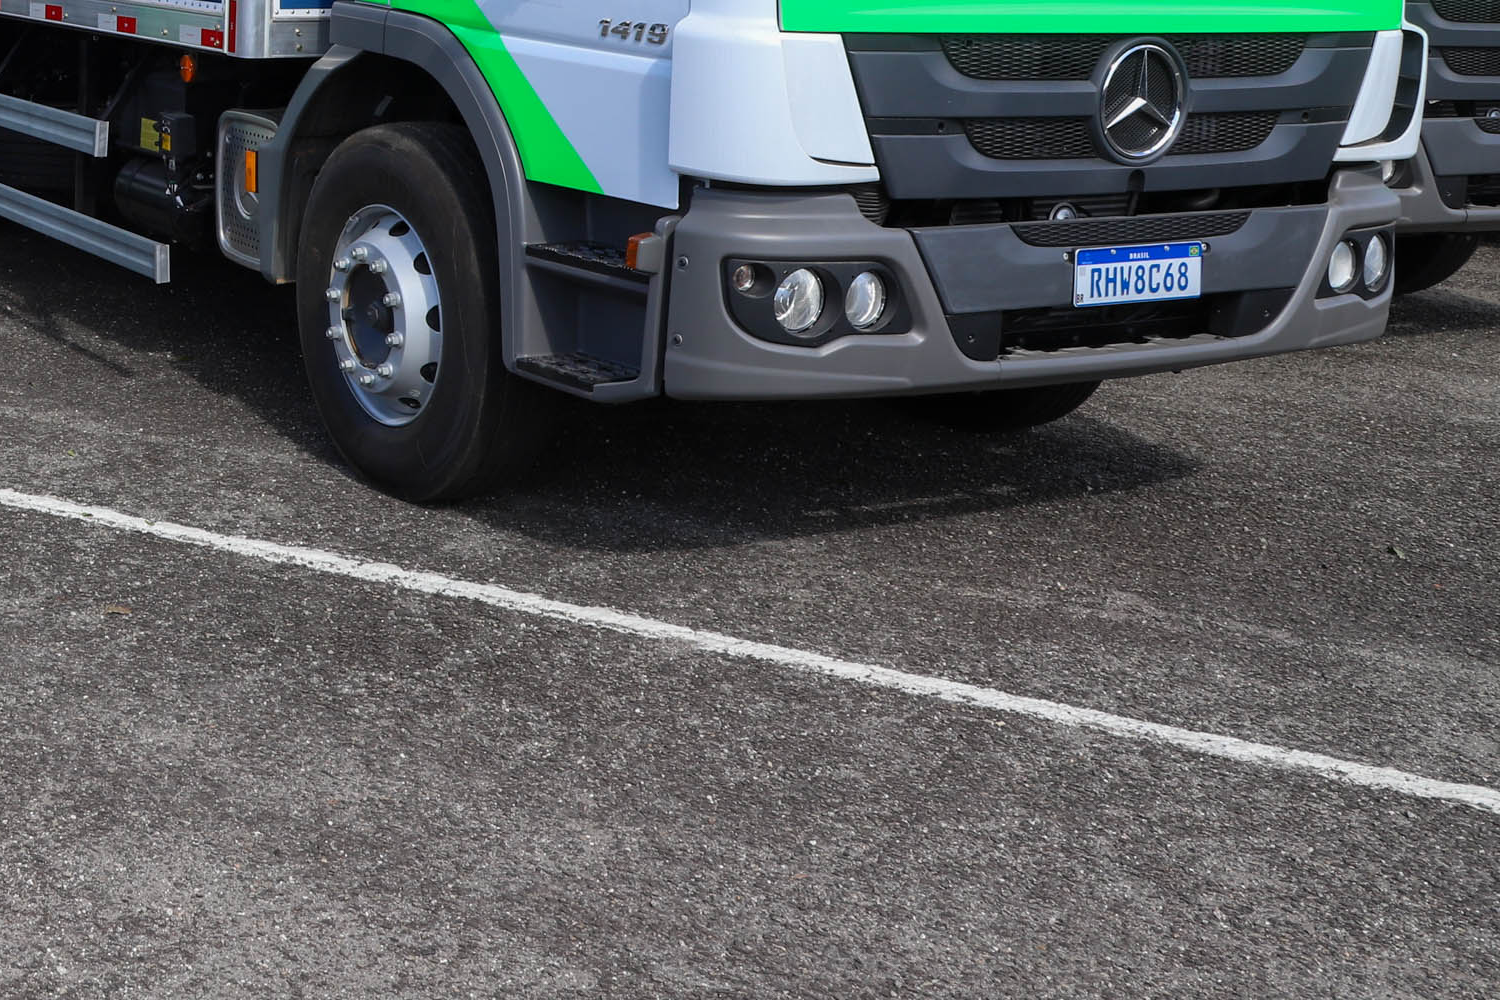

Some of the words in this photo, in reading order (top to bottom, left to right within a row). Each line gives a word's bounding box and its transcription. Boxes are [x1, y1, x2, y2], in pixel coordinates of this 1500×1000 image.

[599, 17, 669, 46] 1419
[1129, 252, 1150, 260] BRASIL
[1090, 261, 1189, 298] RHW8C68
